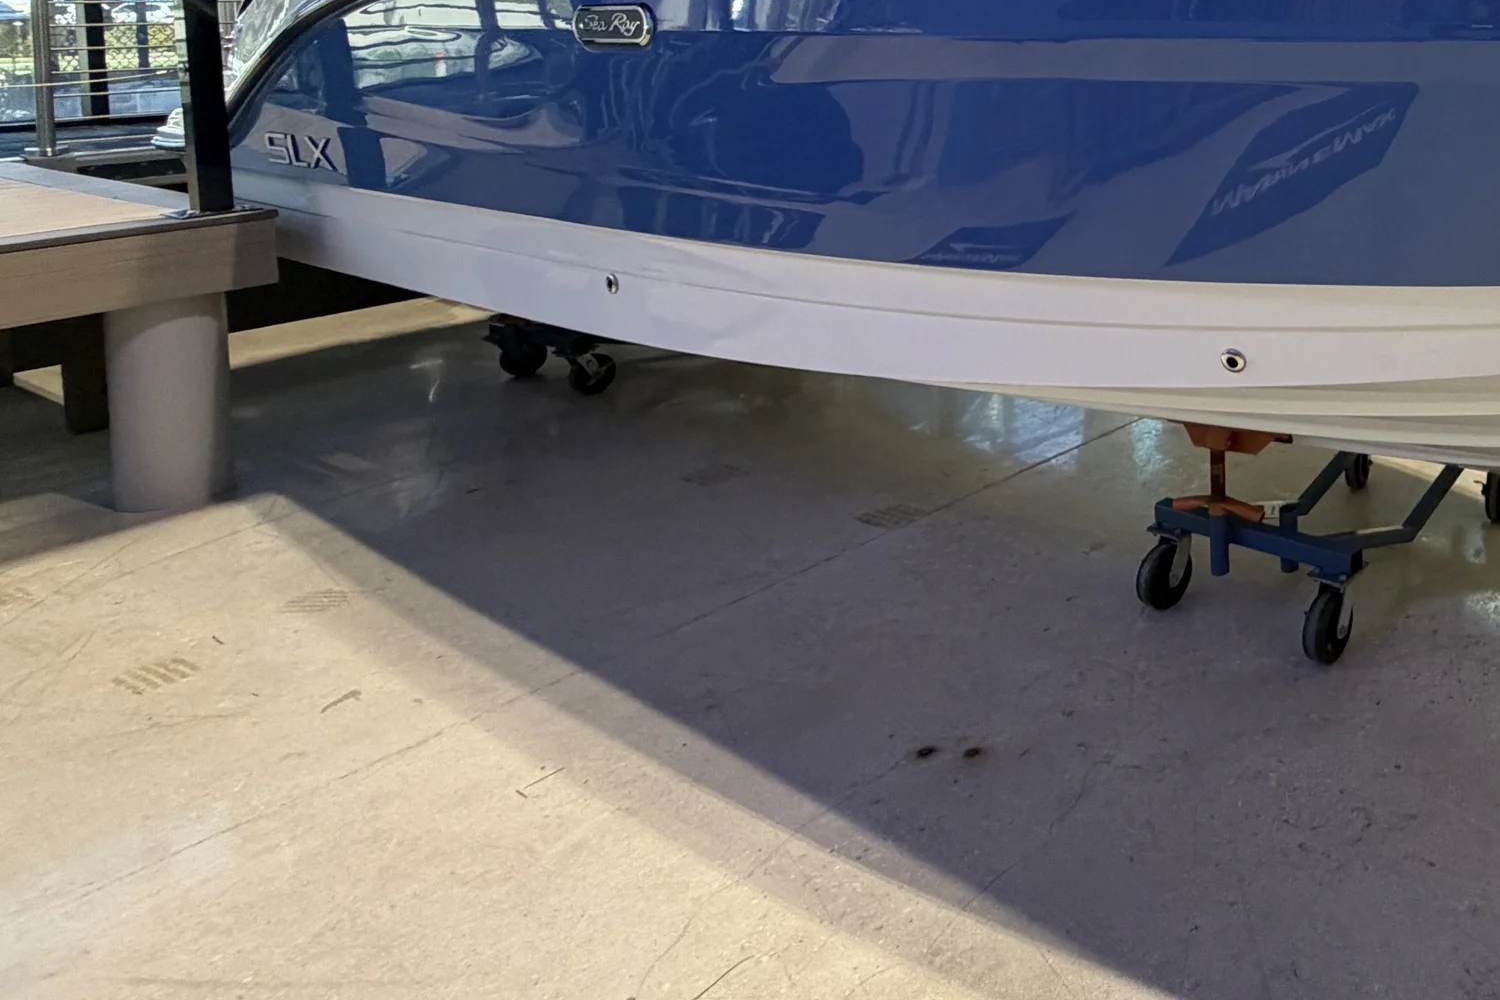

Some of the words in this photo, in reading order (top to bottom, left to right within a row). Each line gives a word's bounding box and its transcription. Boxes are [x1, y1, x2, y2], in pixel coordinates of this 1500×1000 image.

[584, 14, 608, 31] Sea
[608, 12, 640, 37] Ray
[264, 132, 335, 171] SLX
